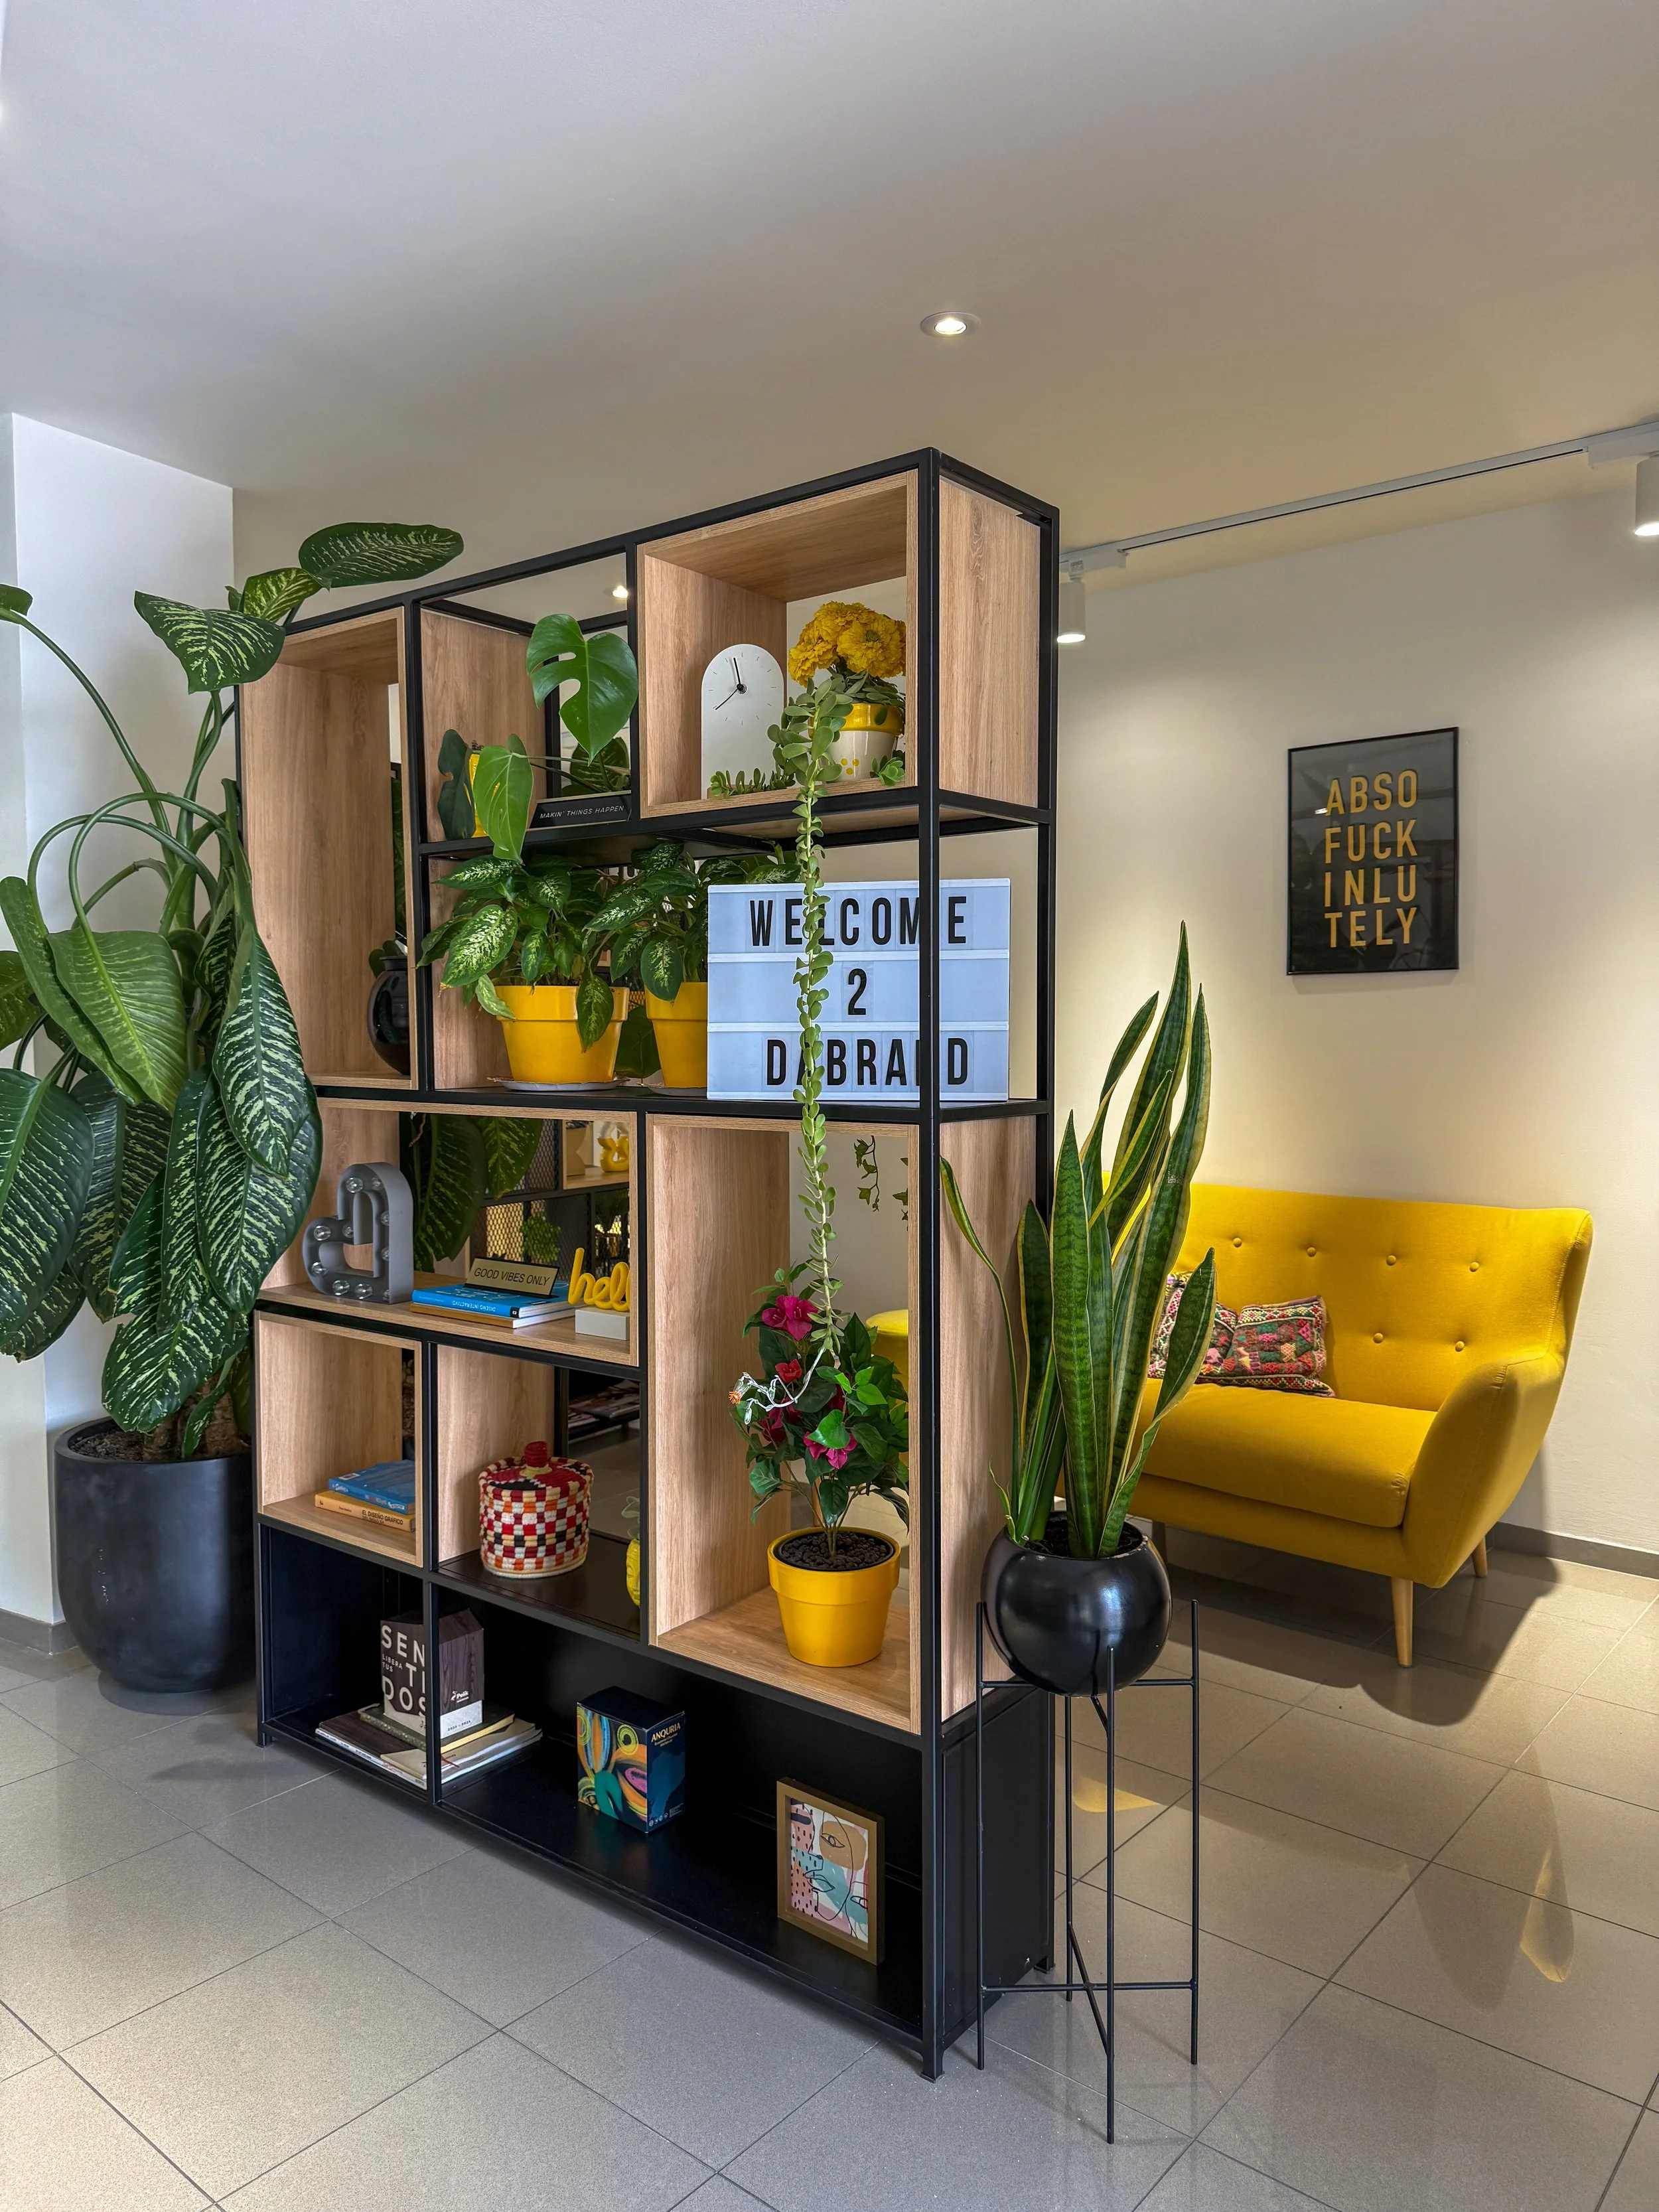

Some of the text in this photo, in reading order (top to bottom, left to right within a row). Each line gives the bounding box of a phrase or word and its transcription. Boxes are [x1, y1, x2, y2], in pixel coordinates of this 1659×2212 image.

[595, 805, 624, 814] HAPPEN
[1325, 769, 1417, 816] ABSO
[1325, 819, 1417, 863] FUCK
[1325, 865, 1416, 907] INLU
[1325, 907, 1417, 948] TELY
[847, 968, 867, 1015] 2
[766, 1037, 968, 1086] DBRAD
[474, 1268, 550, 1286] GOOD VIBES ONLY
[452, 1300, 479, 1309] INTERACTIVO
[382, 1625, 425, 1667] SEN
[382, 1653, 403, 1670] LIBERA
[382, 1662, 394, 1672] TUS
[651, 1722, 681, 1742] ANQURIA
